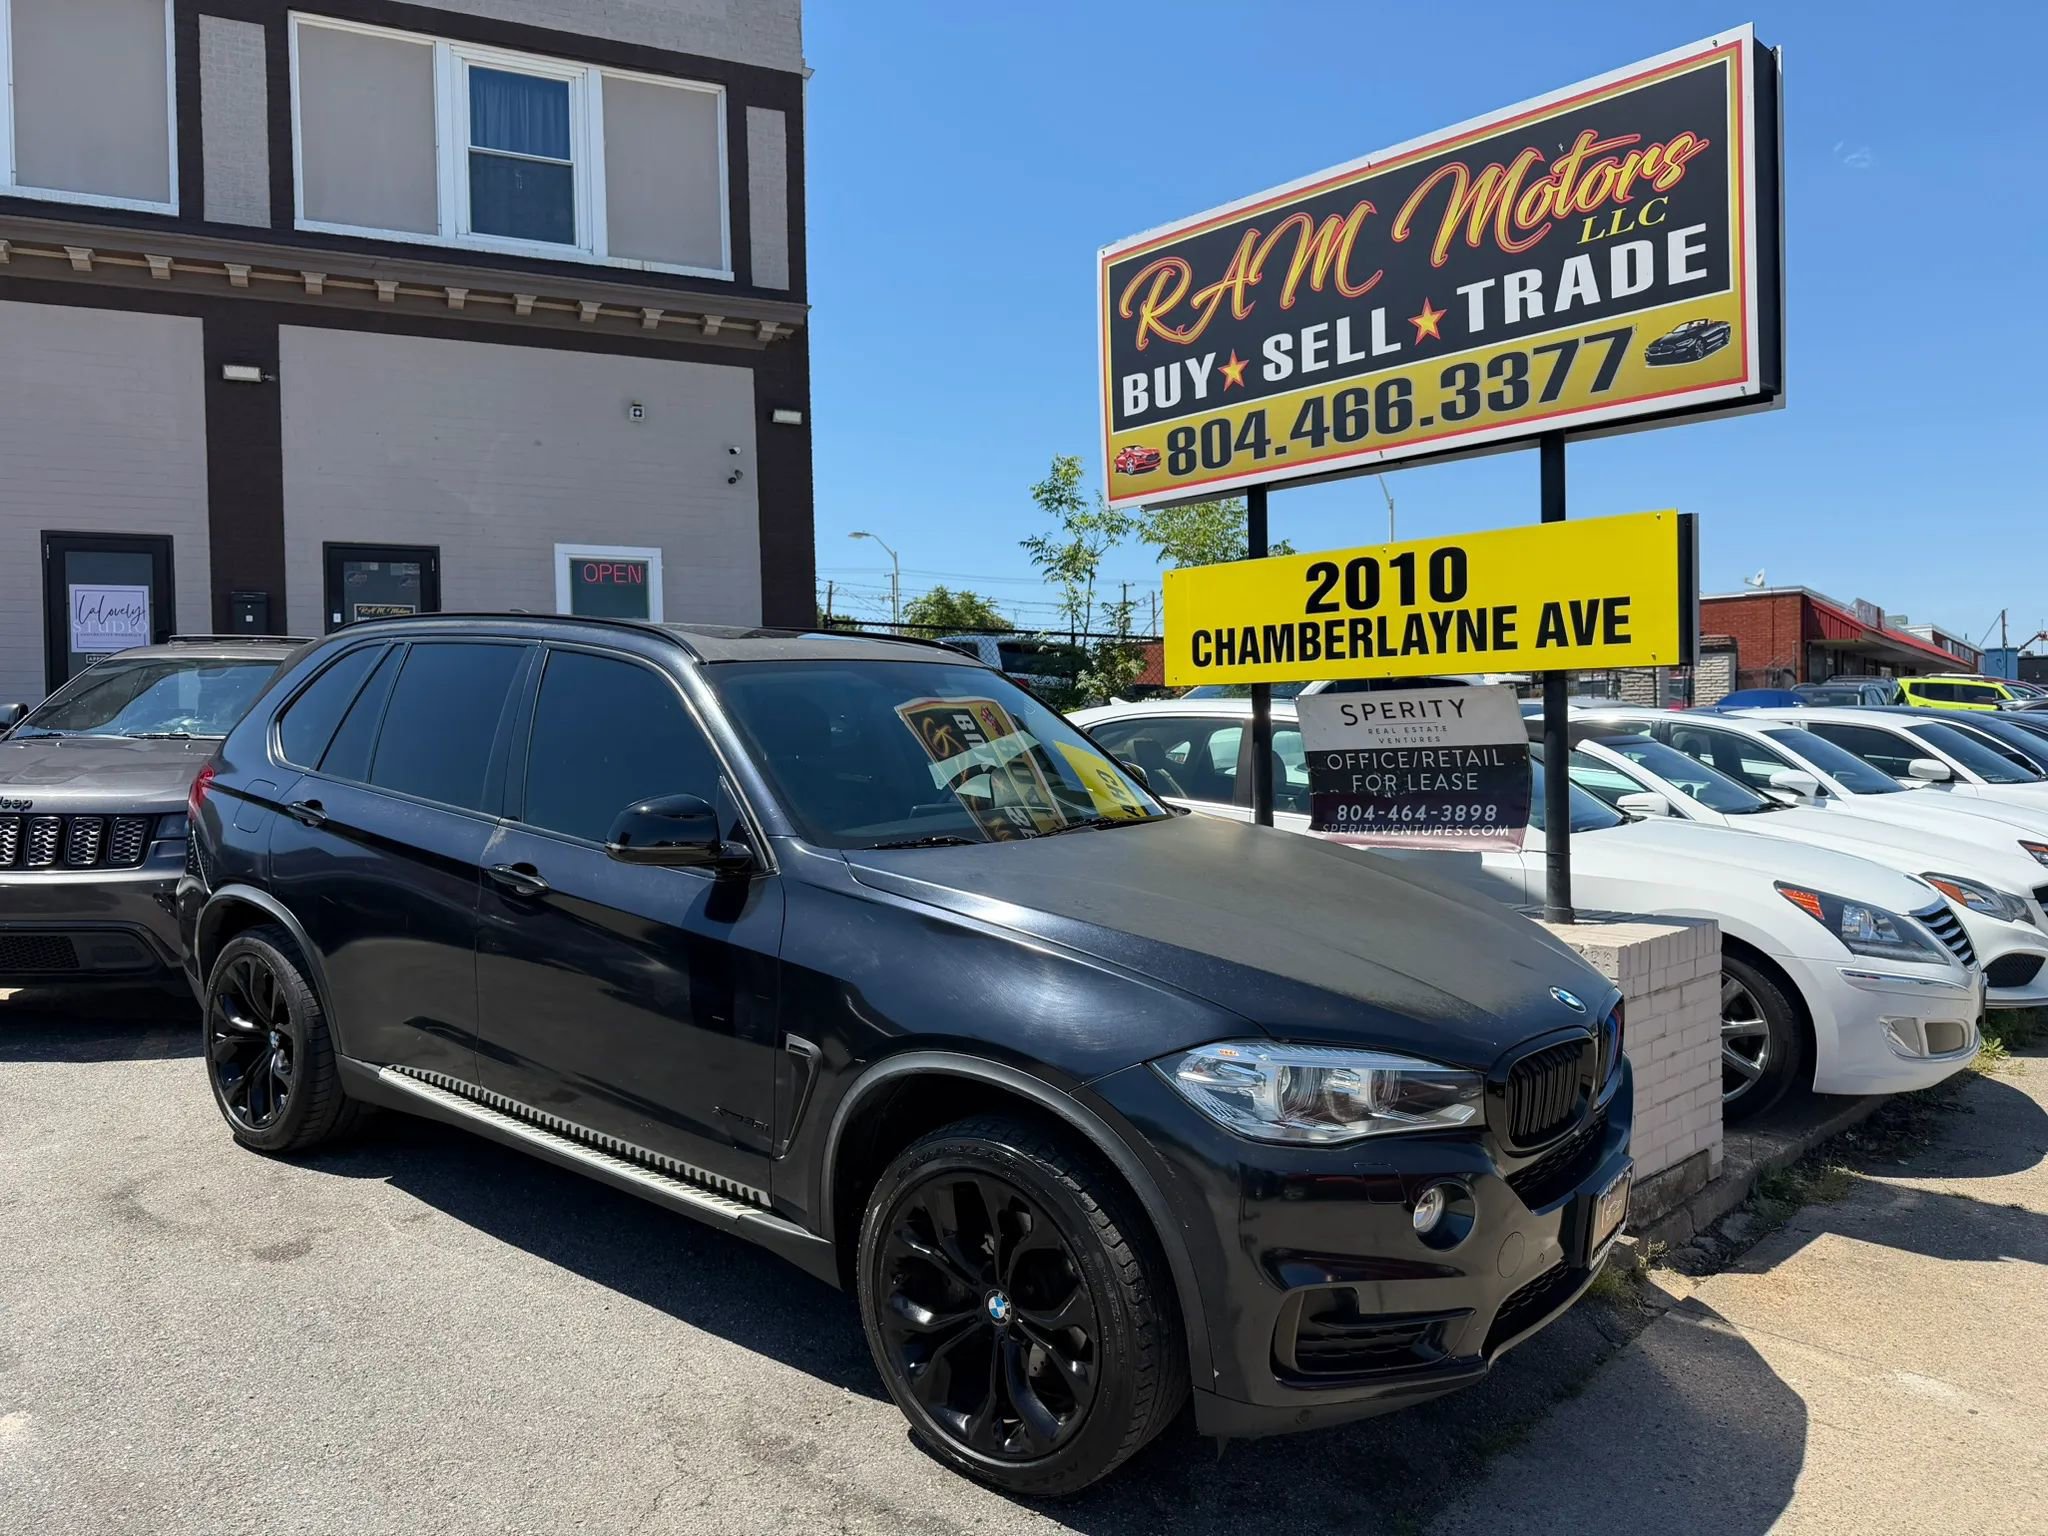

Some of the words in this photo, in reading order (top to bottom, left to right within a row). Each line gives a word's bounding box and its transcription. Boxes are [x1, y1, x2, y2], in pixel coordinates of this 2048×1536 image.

[1576, 196, 1669, 244] LLC
[1120, 200, 1383, 350] RAM
[1392, 129, 1710, 267] Motors
[1123, 352, 1217, 416] BUY
[1262, 307, 1402, 382] SELL
[1457, 223, 1708, 333] TRADE
[1166, 325, 1639, 477] 804.466.3377
[583, 563, 641, 584] OPEN
[1304, 546, 1468, 615] 2010
[72, 620, 148, 634] STUDIO
[1191, 605, 1519, 668] CHAMBERLAYNE
[1535, 596, 1632, 649] AVE
[1340, 699, 1465, 727] SPERITY
[1368, 727, 1396, 735] REAL
[1404, 725, 1448, 733] ESTATE
[1378, 735, 1441, 744] VENTURES
[1327, 748, 1505, 770] OFFICE/RETAIL
[1352, 774, 1397, 792] FOR
[1408, 773, 1479, 791] LEASE
[1337, 804, 1498, 822] 804-464-3898
[1321, 823, 1509, 838] SPERITYVENTURES.COM
